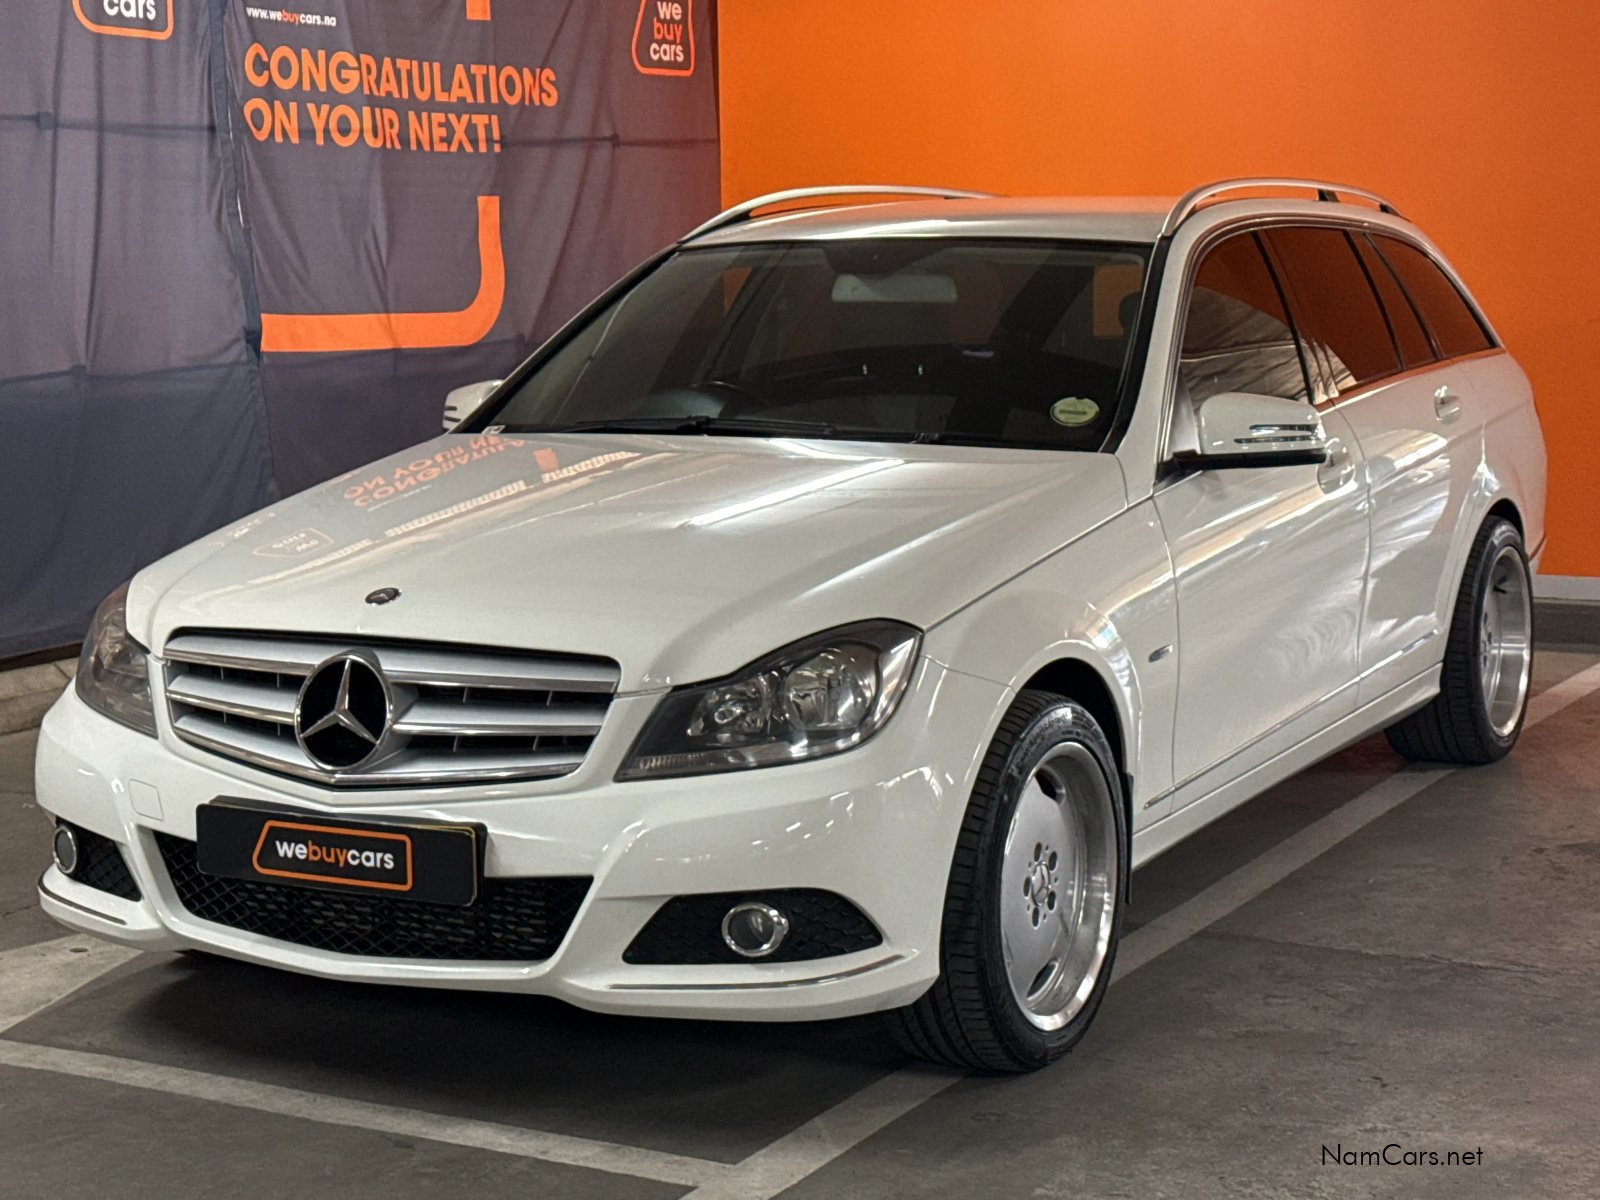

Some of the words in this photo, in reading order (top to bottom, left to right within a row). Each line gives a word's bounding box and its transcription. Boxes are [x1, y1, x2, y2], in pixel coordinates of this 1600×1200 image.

[103, 0, 157, 20] cars
[246, 6, 337, 27] www.webuycars.na
[657, 1, 682, 20] we
[653, 16, 682, 44] buy
[650, 42, 684, 62] cars
[244, 42, 559, 107] CONGRATULATIONS
[243, 97, 300, 145] ON
[306, 103, 401, 150] YOUR
[408, 111, 501, 153] NEXT!
[275, 839, 395, 870] webuycars
